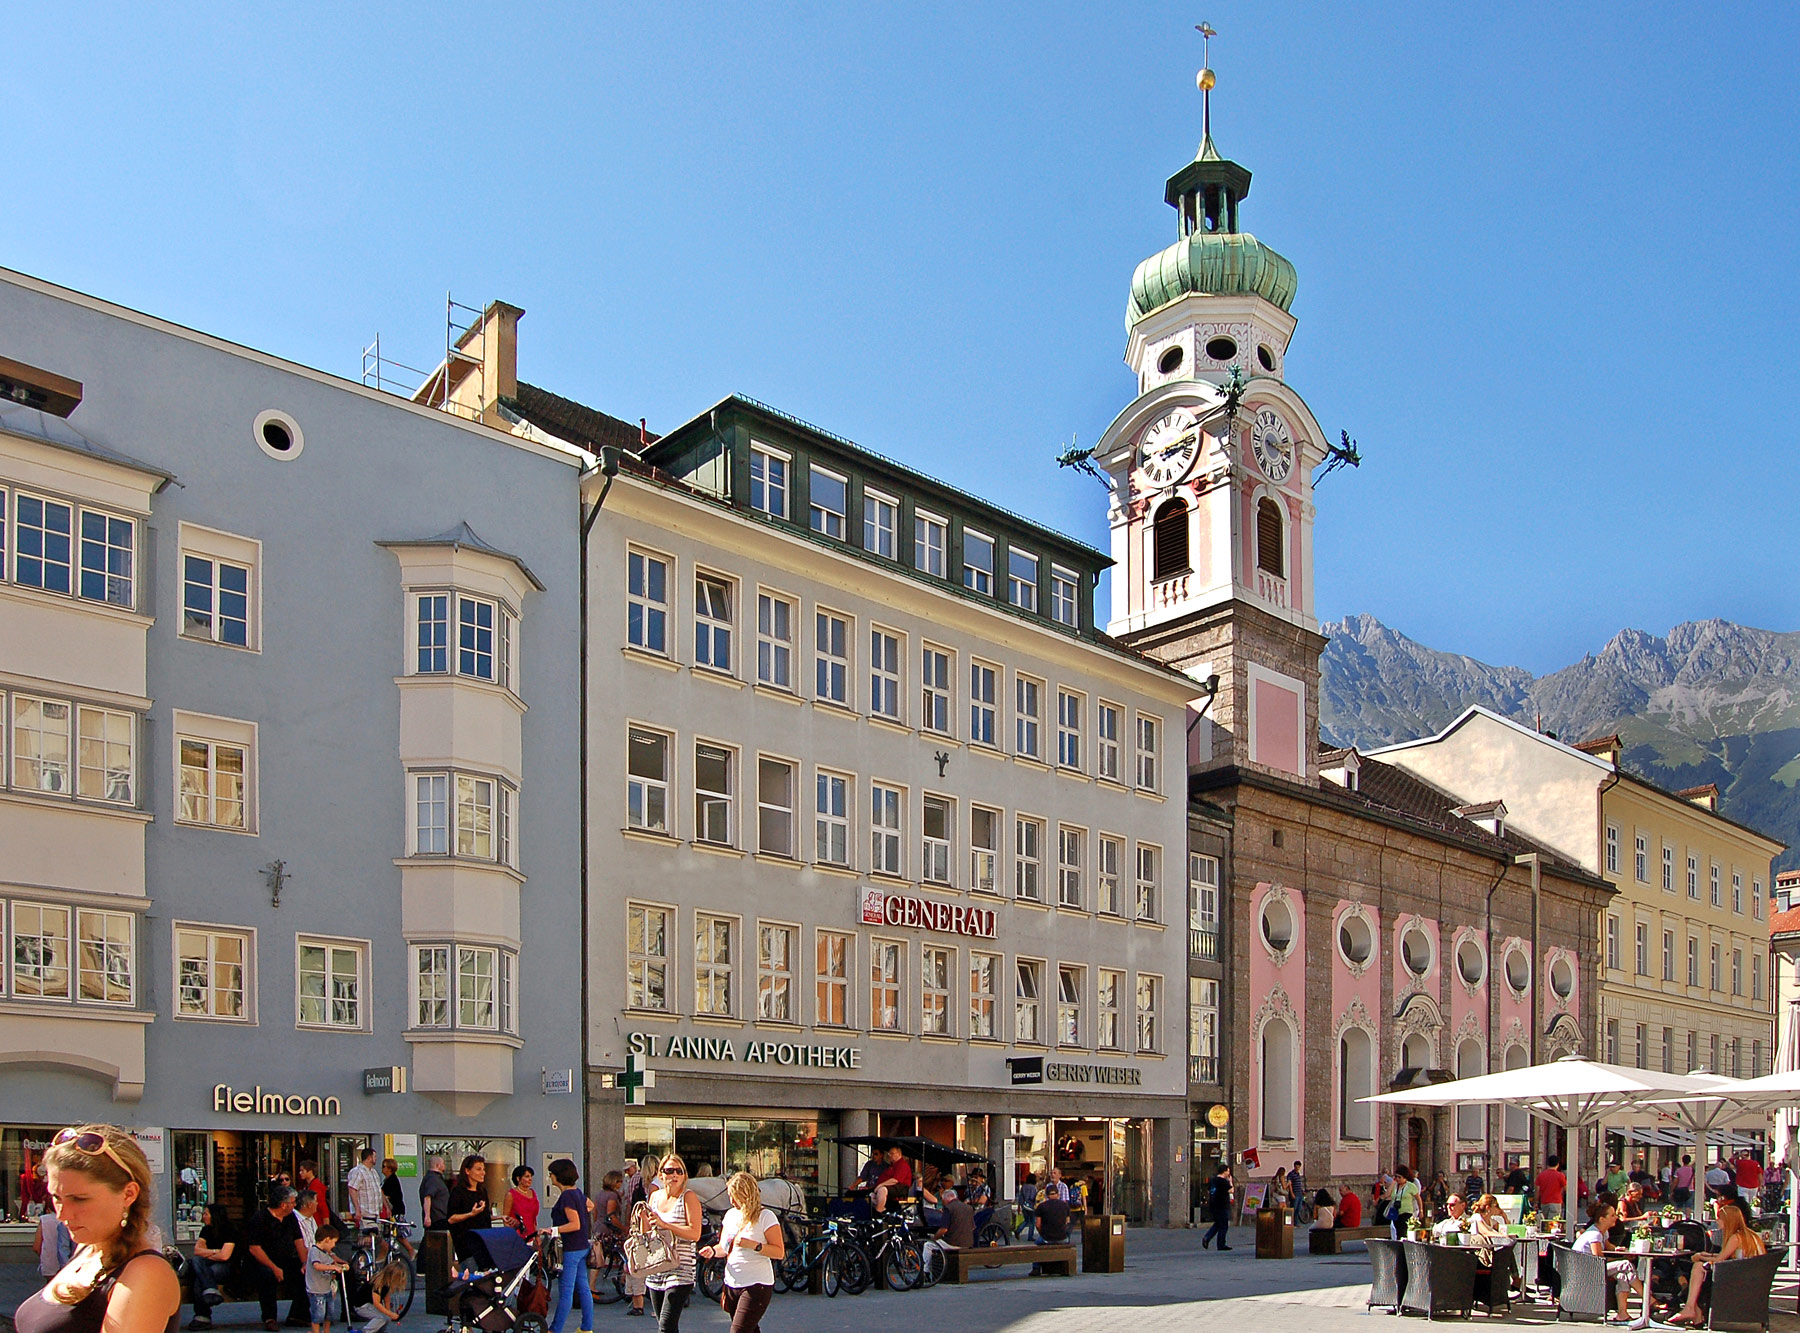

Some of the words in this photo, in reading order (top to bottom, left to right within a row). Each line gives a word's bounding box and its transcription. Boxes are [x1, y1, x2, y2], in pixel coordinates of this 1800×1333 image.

[885, 895, 1000, 939] GENERALI
[628, 1032, 661, 1058] ST.
[667, 1036, 737, 1062] ANNA
[745, 1042, 863, 1069] APOTHEKE
[1046, 1063, 1094, 1082] GERRY
[1095, 1066, 1142, 1085] WEBER
[213, 1083, 342, 1116] fielmann
[551, 1120, 558, 1130] 6
